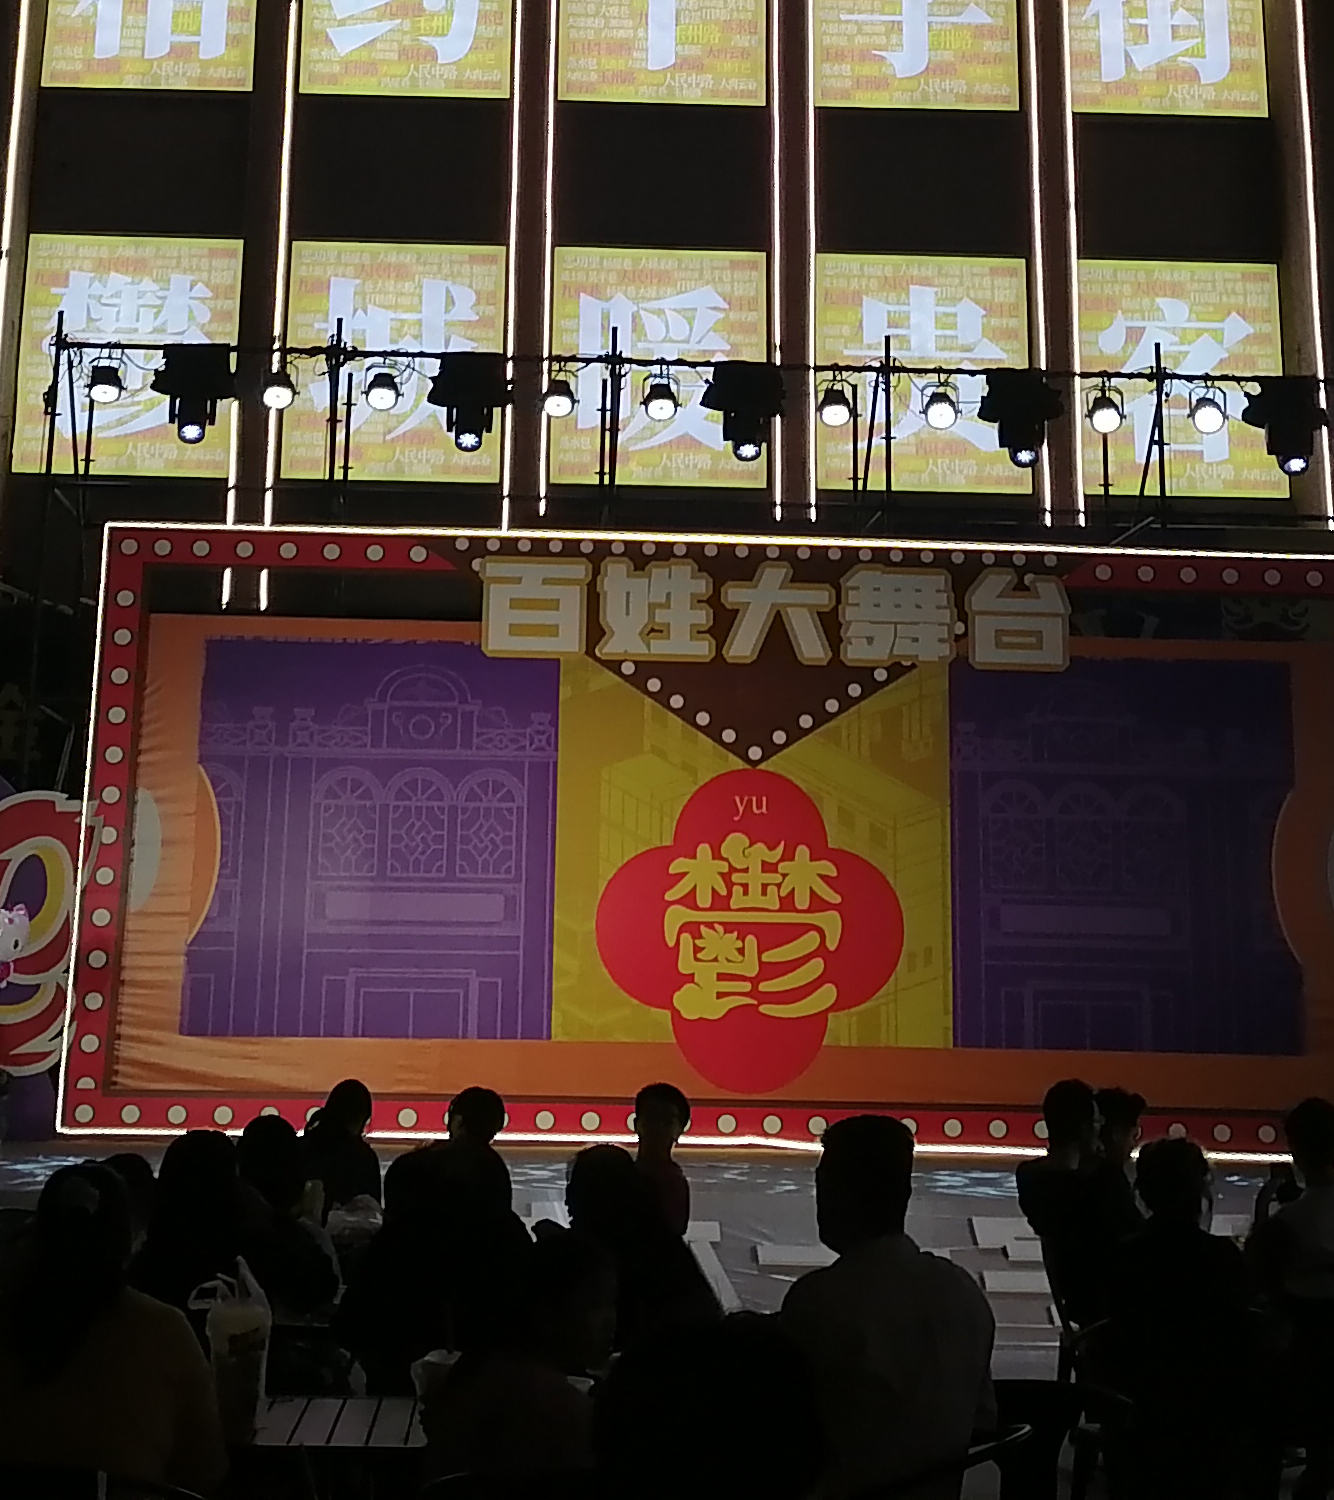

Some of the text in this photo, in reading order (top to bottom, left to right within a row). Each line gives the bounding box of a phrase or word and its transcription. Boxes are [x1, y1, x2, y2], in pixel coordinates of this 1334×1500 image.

[407, 64, 458, 79] 人民中路
[664, 73, 714, 89] 人民中路
[918, 79, 966, 94] 人民中路
[1167, 84, 1216, 99] 人民中路
[393, 447, 445, 463] 人民中路
[660, 452, 713, 468] 人民中路
[481, 556, 1073, 672] 百姓大舞台
